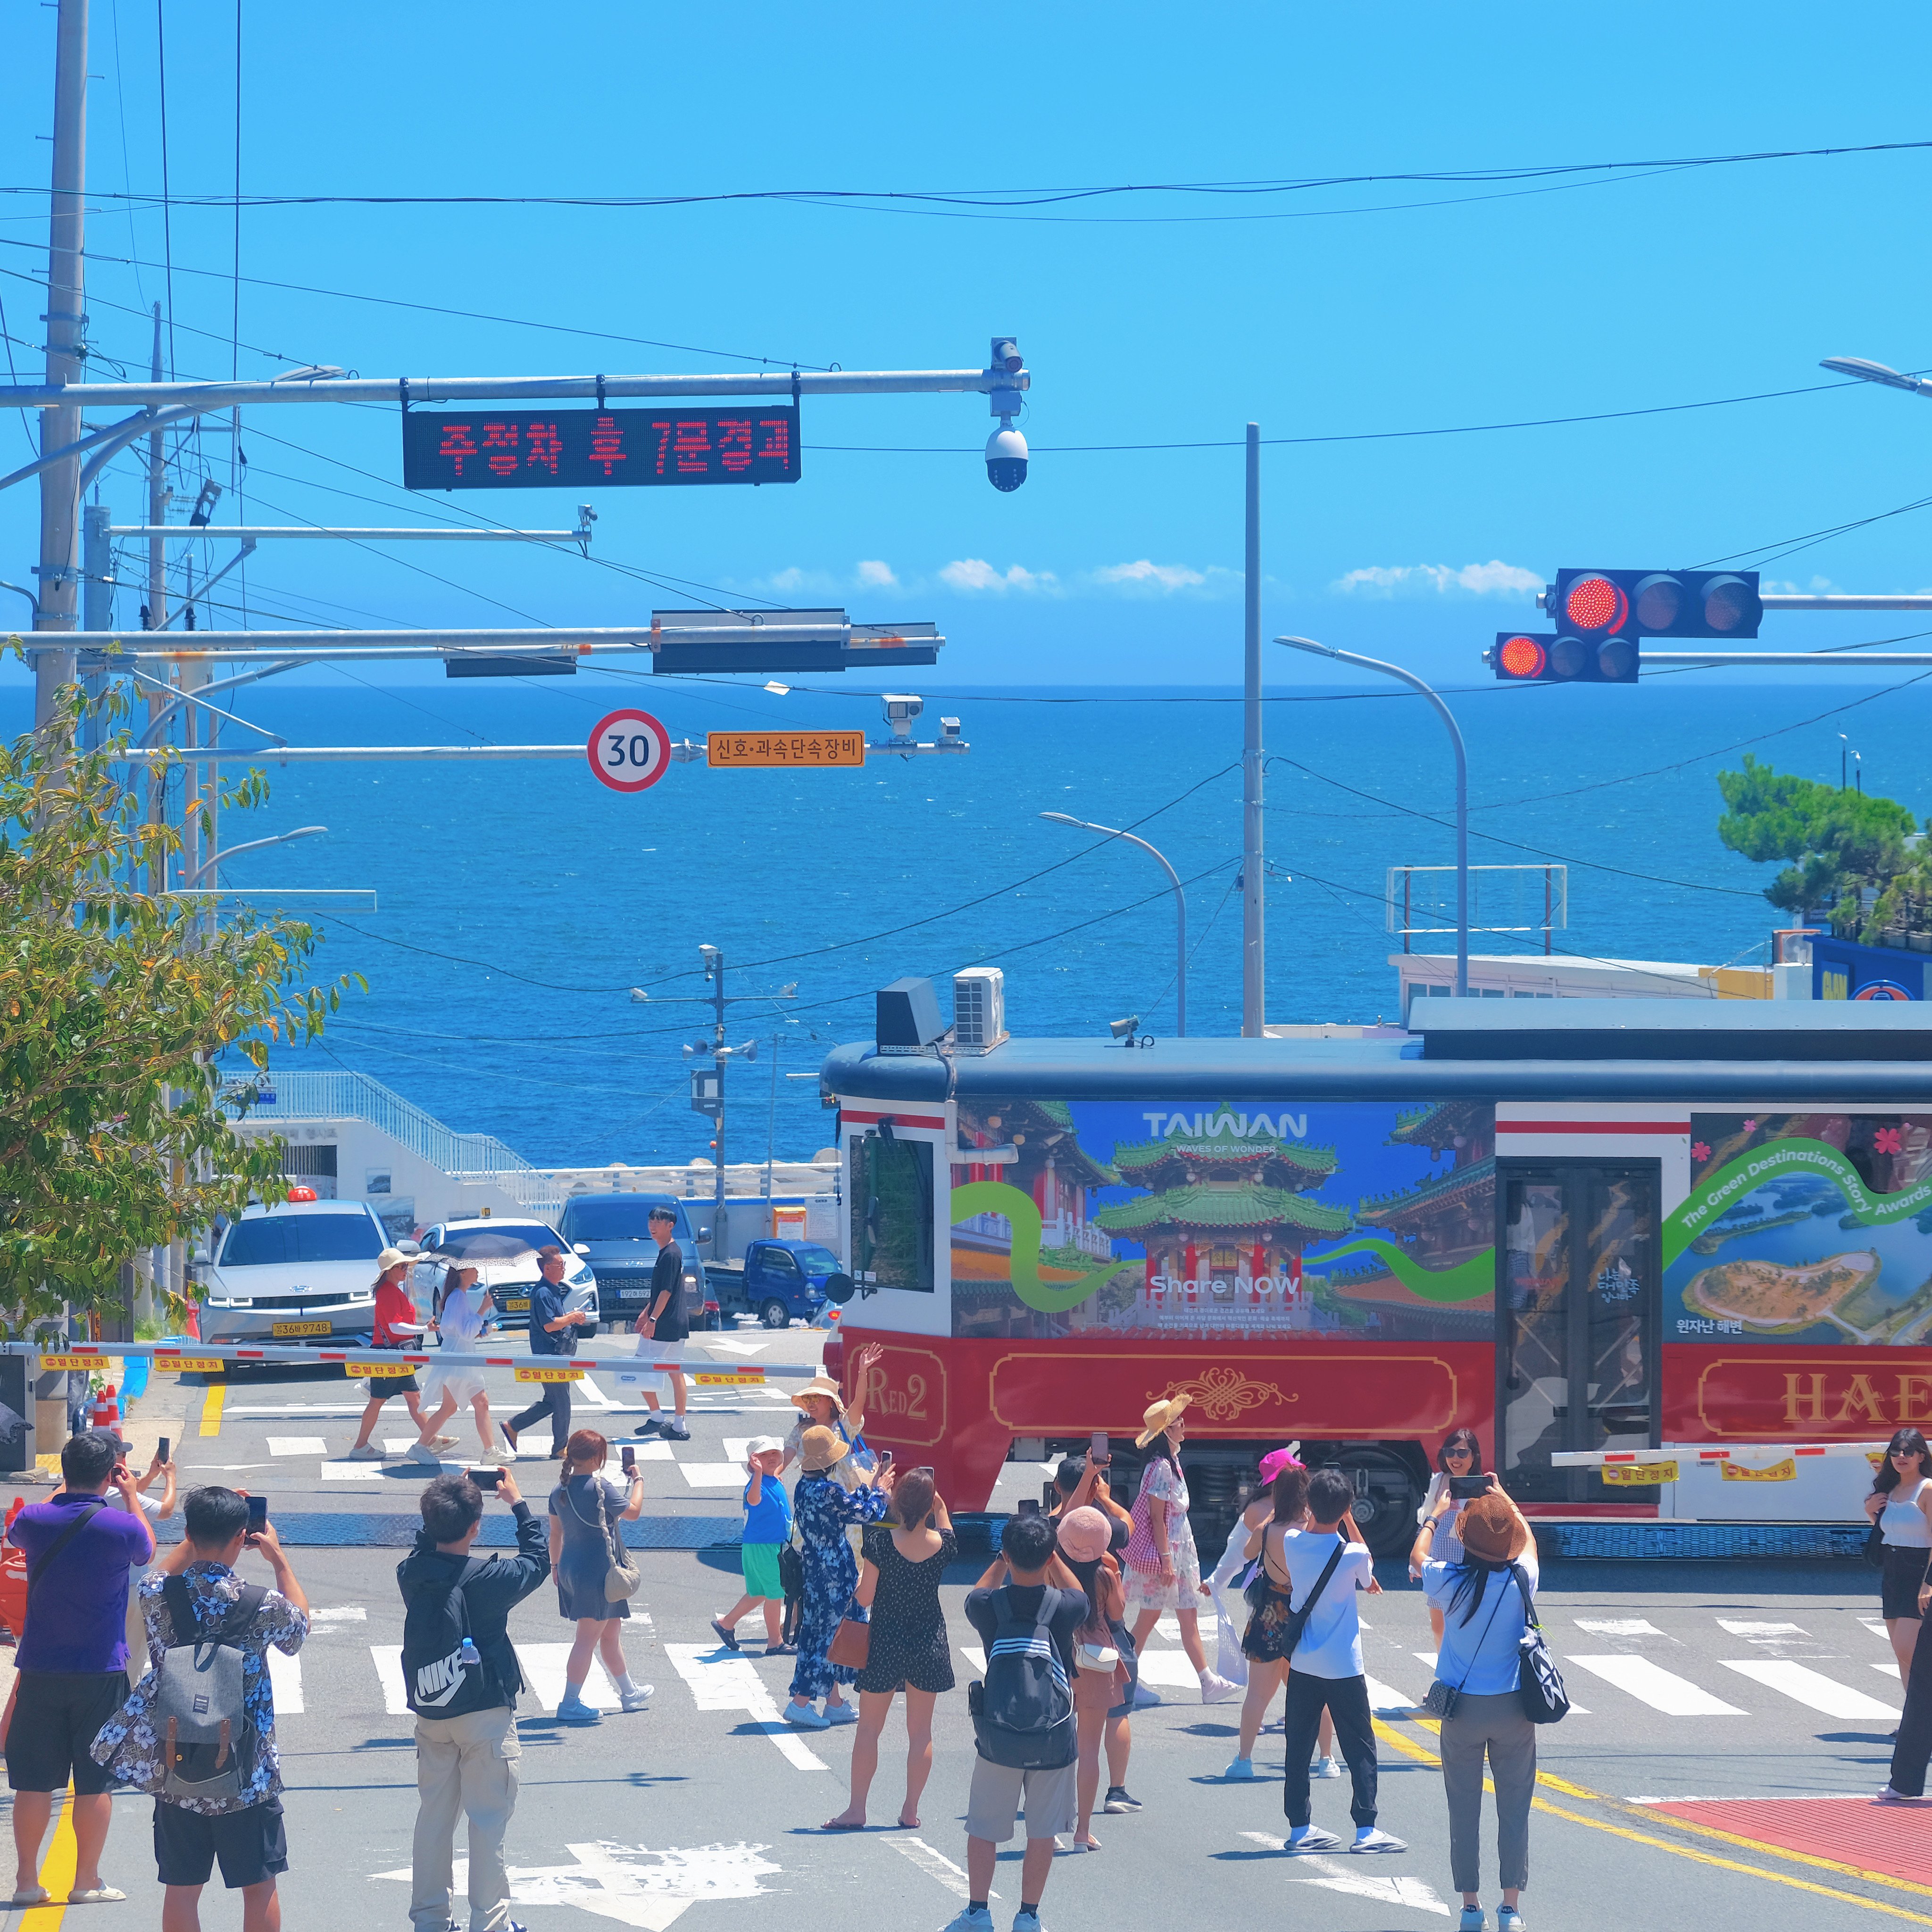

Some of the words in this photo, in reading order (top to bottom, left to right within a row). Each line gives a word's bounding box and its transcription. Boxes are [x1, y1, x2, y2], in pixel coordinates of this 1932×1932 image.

[439, 423, 563, 475] 주정차
[589, 417, 627, 475] 후
[607, 734, 650, 767] 30
[716, 738, 856, 760] 신호·과속단속장비
[1142, 1113, 1307, 1138] TAIWAN
[1176, 1145, 1211, 1153] WAVES
[1215, 1145, 1227, 1153] OF
[1230, 1145, 1276, 1153] WONDER
[1681, 1204, 1708, 1228] The
[1707, 1173, 1748, 1206] Green
[1748, 1149, 1845, 1177] Destinations
[1842, 1174, 1873, 1213] Story
[1874, 1184, 1932, 1216] Awards
[1150, 1275, 1227, 1293] Share
[1234, 1276, 1300, 1294] NOW
[303, 1323, 327, 1333] 9748
[1716, 1319, 1743, 1335] 해변
[1621, 1467, 1674, 1481] 일단정지
[417, 1646, 466, 1698] NIKE
